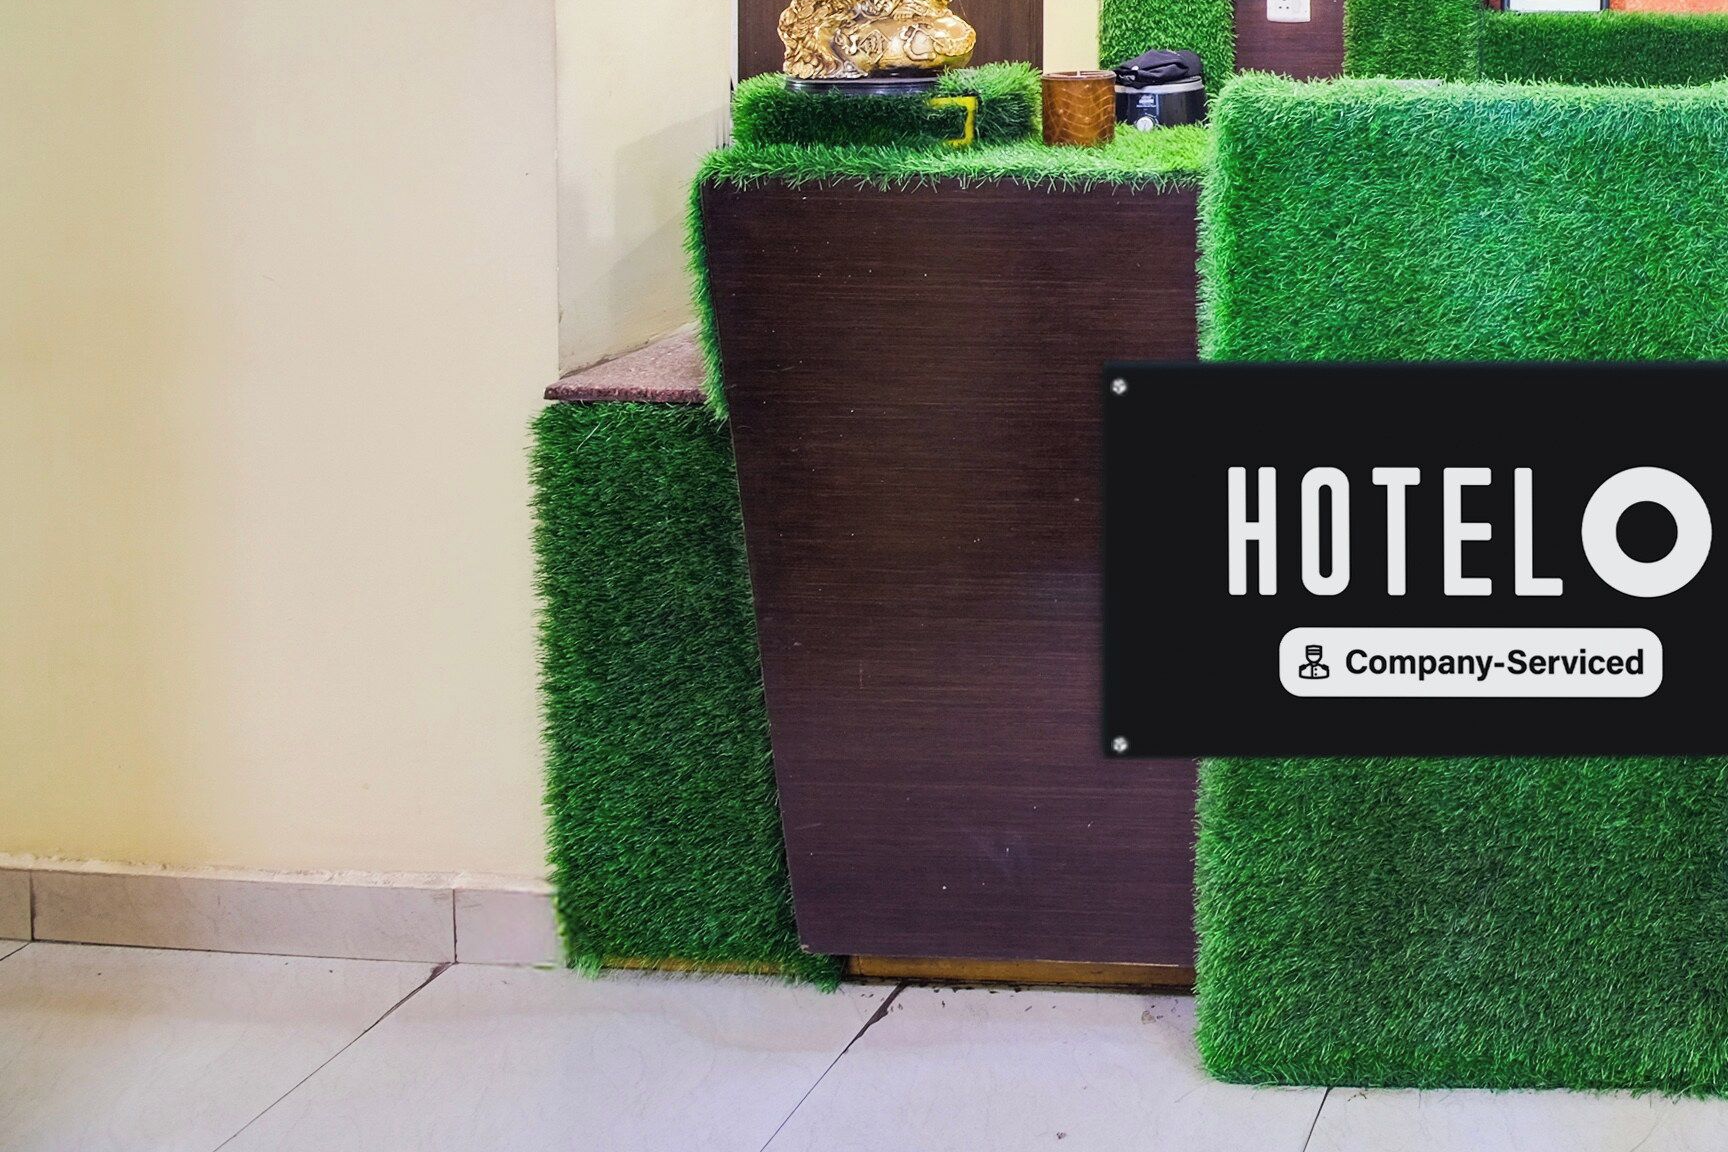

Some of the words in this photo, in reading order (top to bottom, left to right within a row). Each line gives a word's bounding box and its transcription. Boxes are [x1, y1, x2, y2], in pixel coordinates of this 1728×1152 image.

[1227, 466, 1564, 596] HOTEL
[1581, 466, 1713, 598] O
[1345, 648, 1644, 681] Company-Serviced
